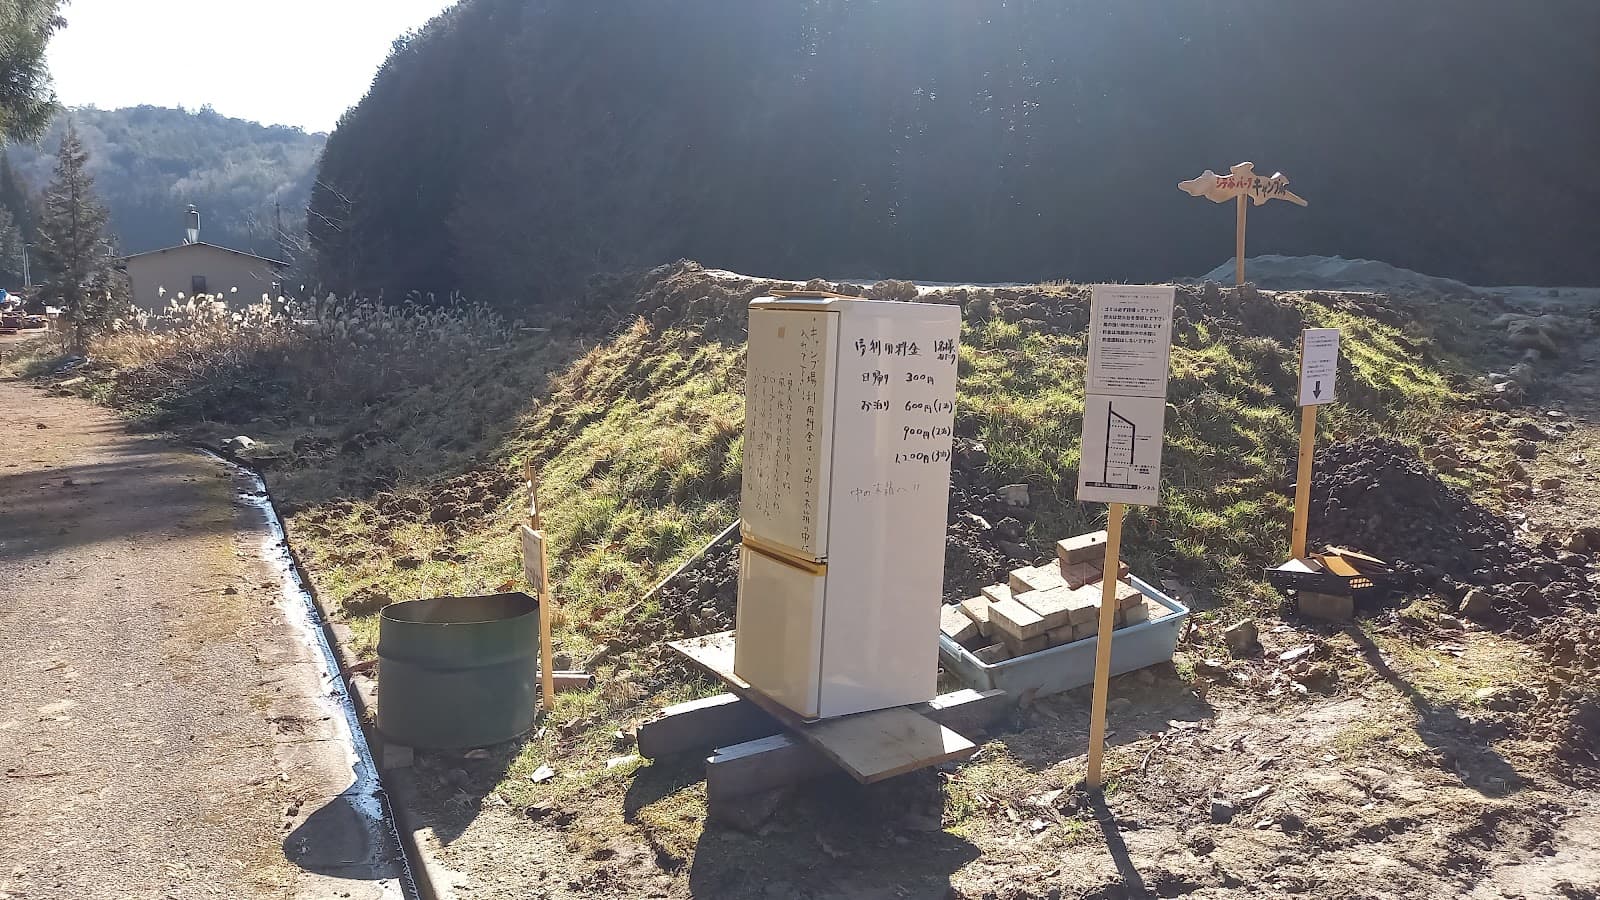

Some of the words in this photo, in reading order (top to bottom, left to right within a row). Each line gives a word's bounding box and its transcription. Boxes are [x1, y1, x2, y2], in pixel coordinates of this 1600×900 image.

[861, 370, 889, 386] 日帰り
[905, 372, 934, 385] 300円
[861, 400, 890, 412] お泊り
